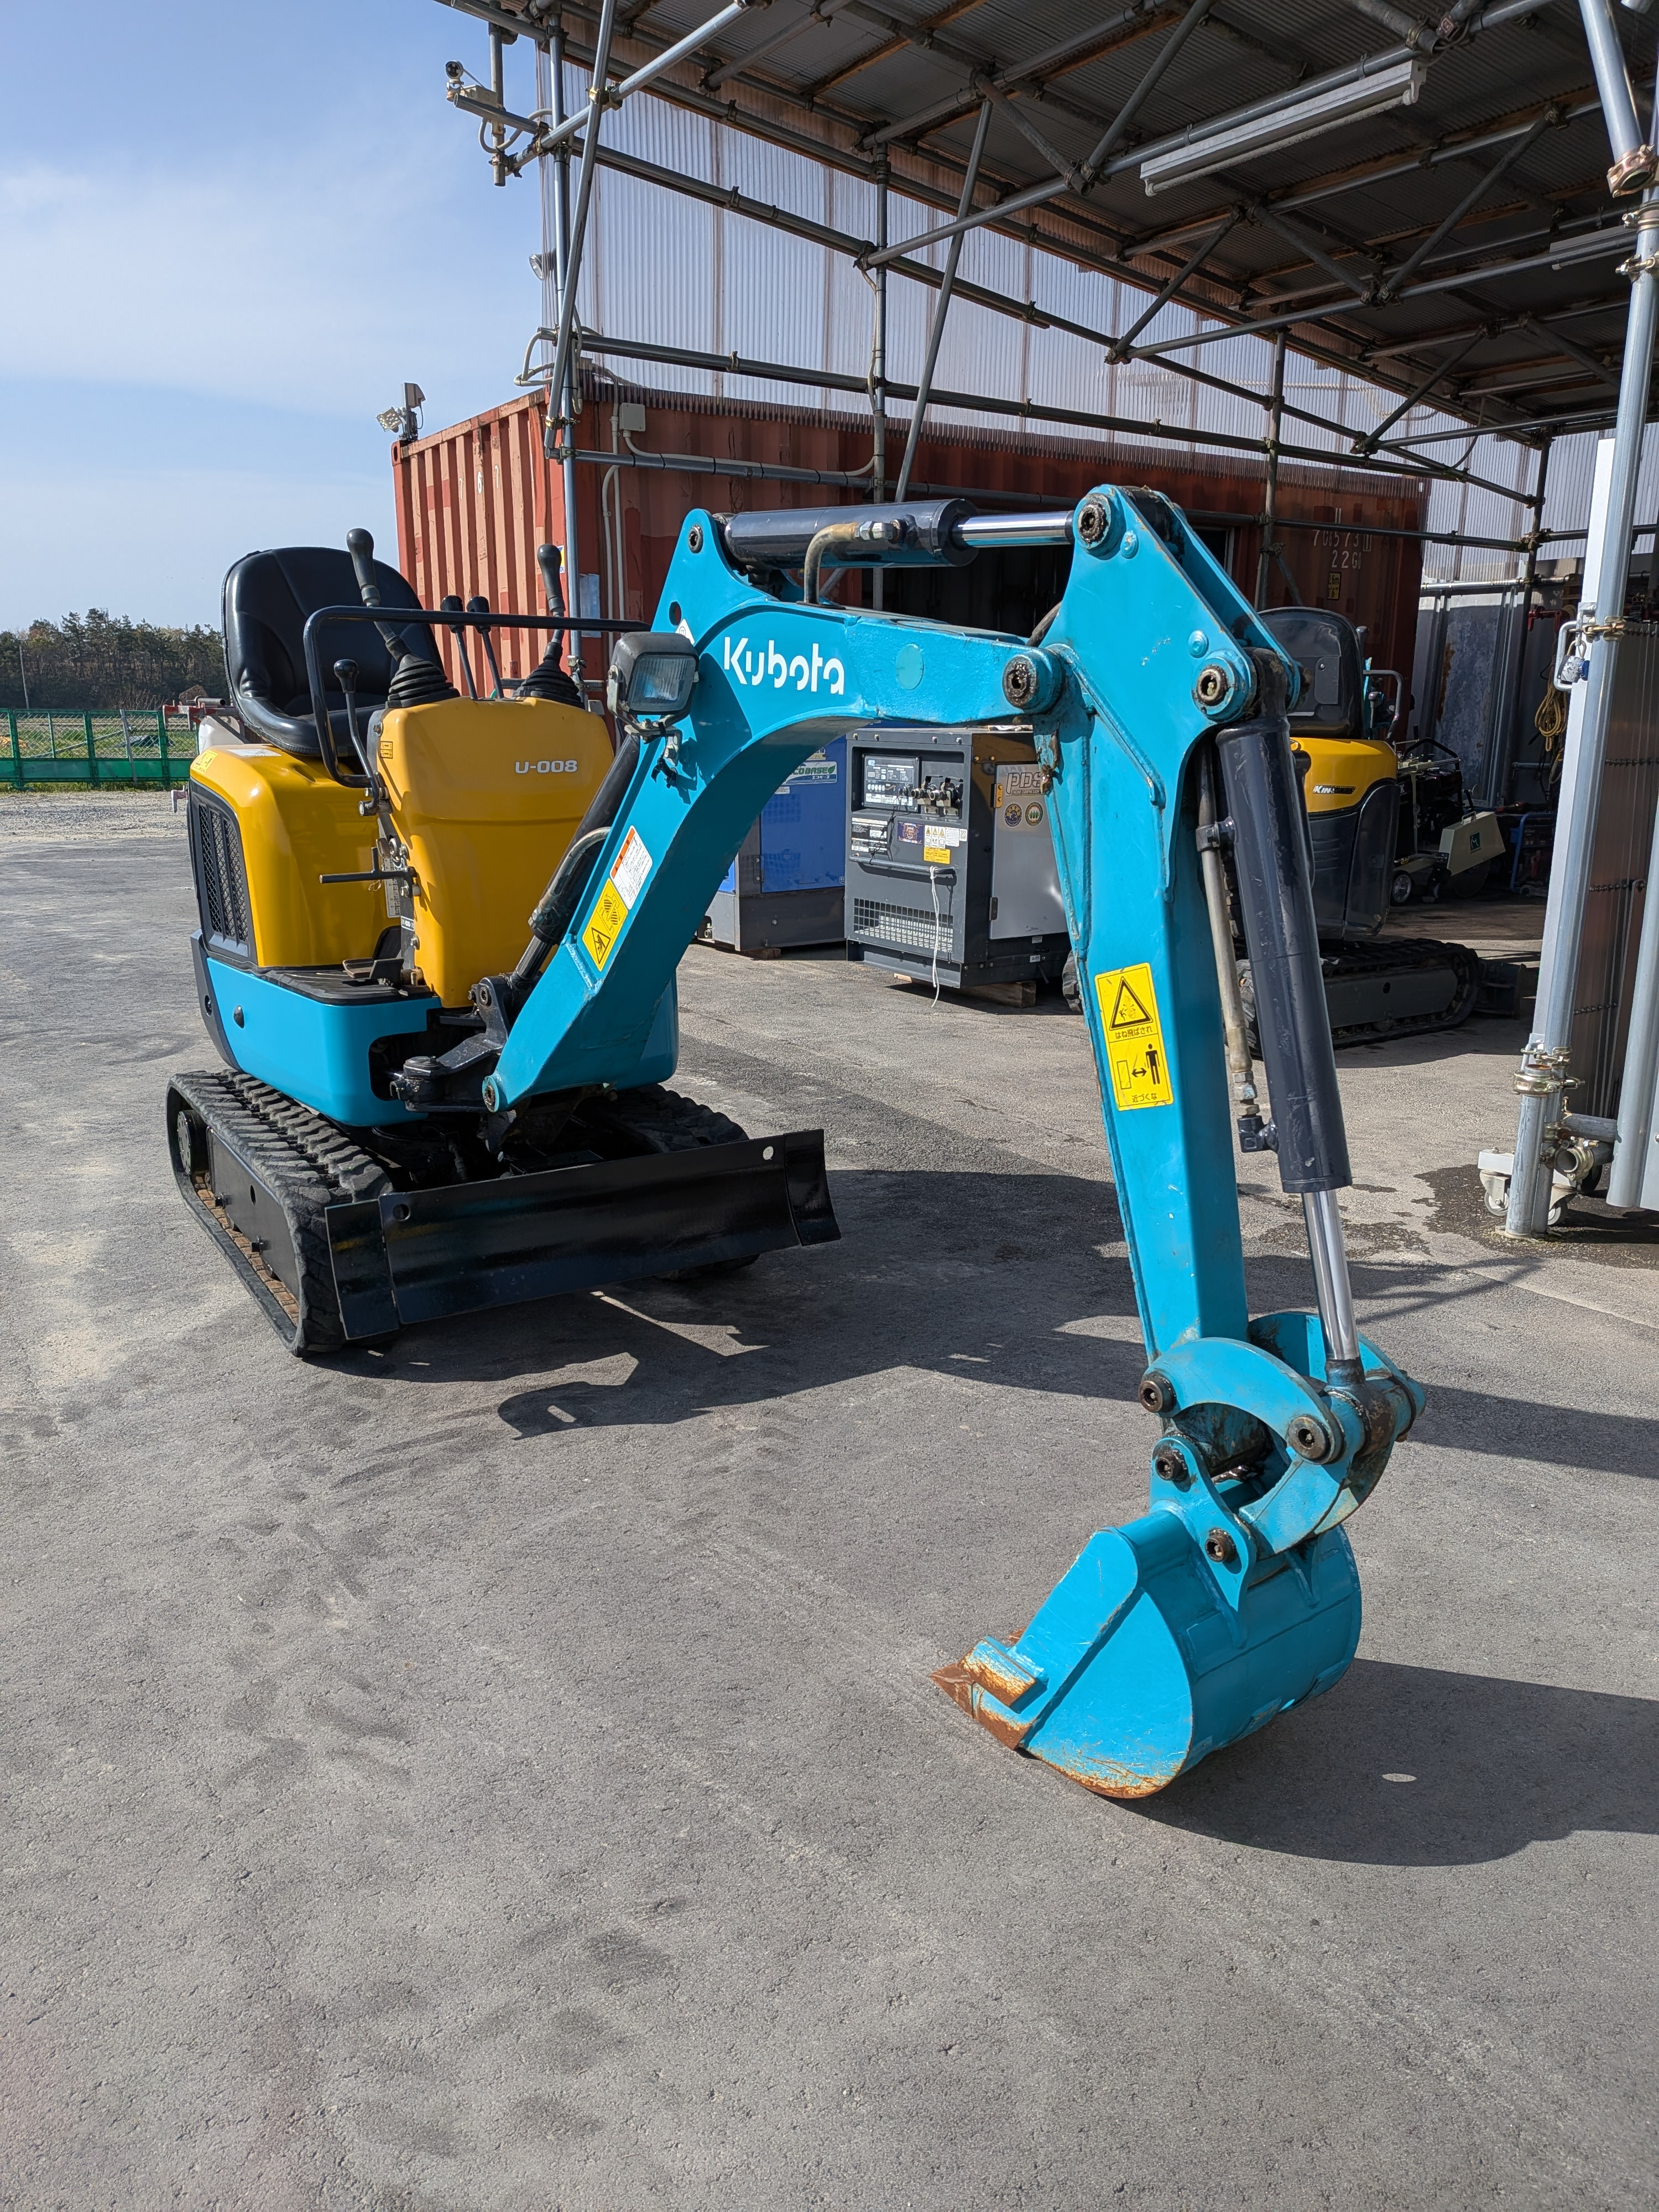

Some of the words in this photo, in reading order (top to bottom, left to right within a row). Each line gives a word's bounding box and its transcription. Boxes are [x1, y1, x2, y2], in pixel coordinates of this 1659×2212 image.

[724, 637, 844, 695] Kubota
[515, 760, 578, 774] U-008
[1115, 1025, 1153, 1040] はね飛ばされ
[1131, 1093, 1158, 1103] 近づくな
